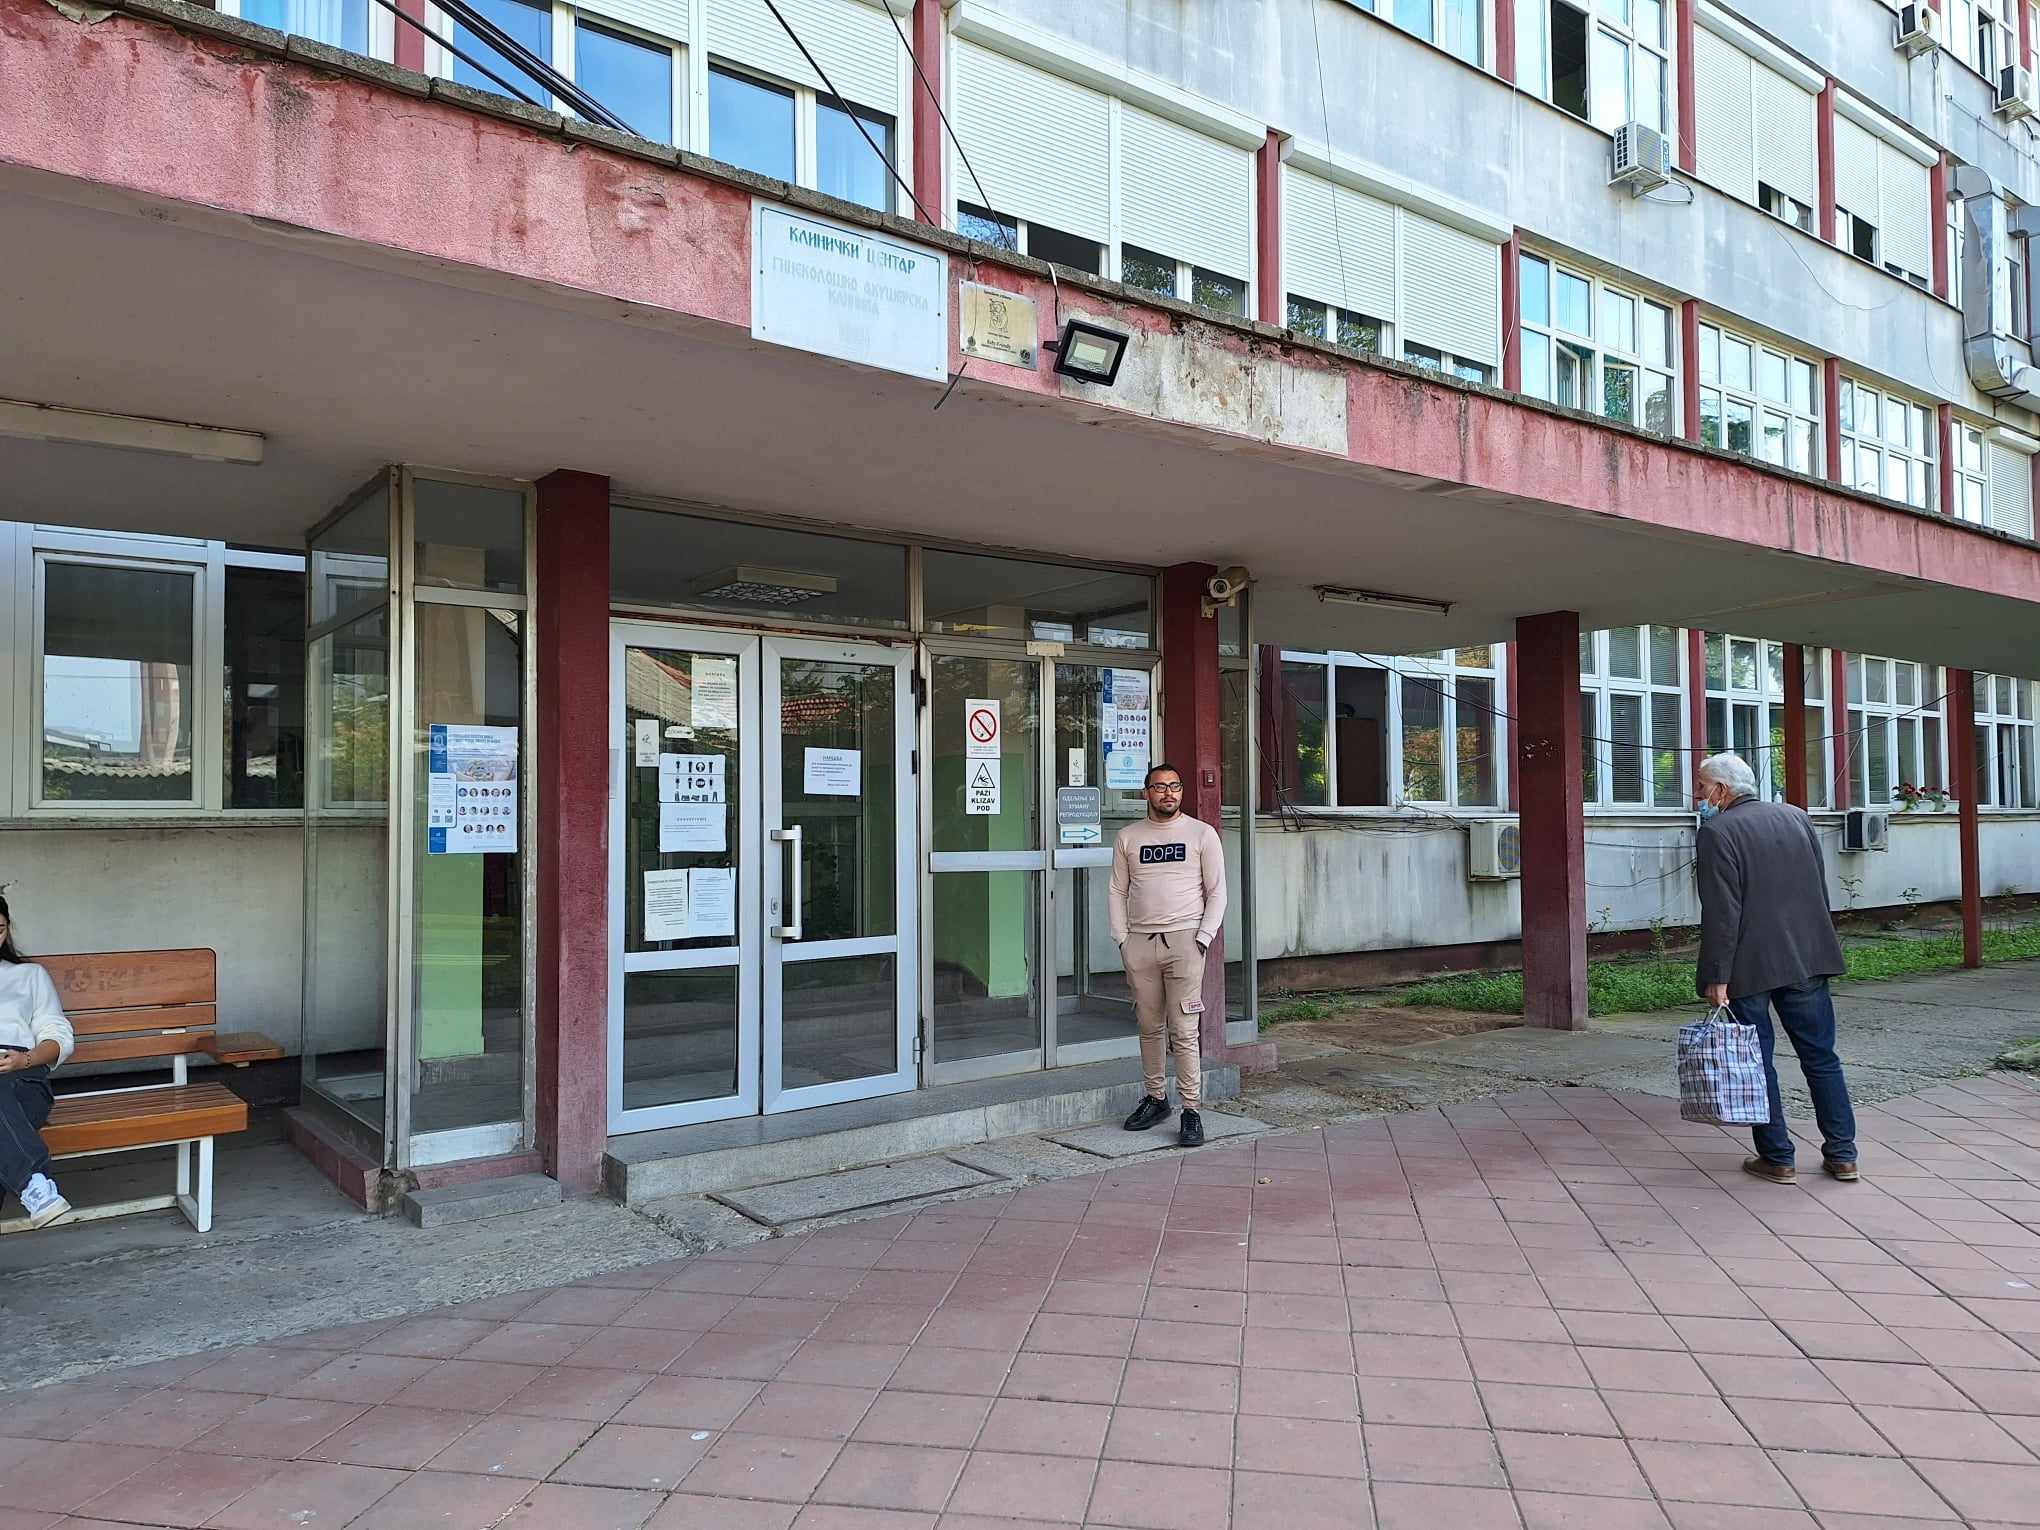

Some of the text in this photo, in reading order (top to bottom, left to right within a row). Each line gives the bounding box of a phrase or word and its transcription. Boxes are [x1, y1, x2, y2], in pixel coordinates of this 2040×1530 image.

[789, 225, 916, 275] КЛИНИЧКИ ЦЕНТАР
[1142, 845, 1185, 861] DOPE
